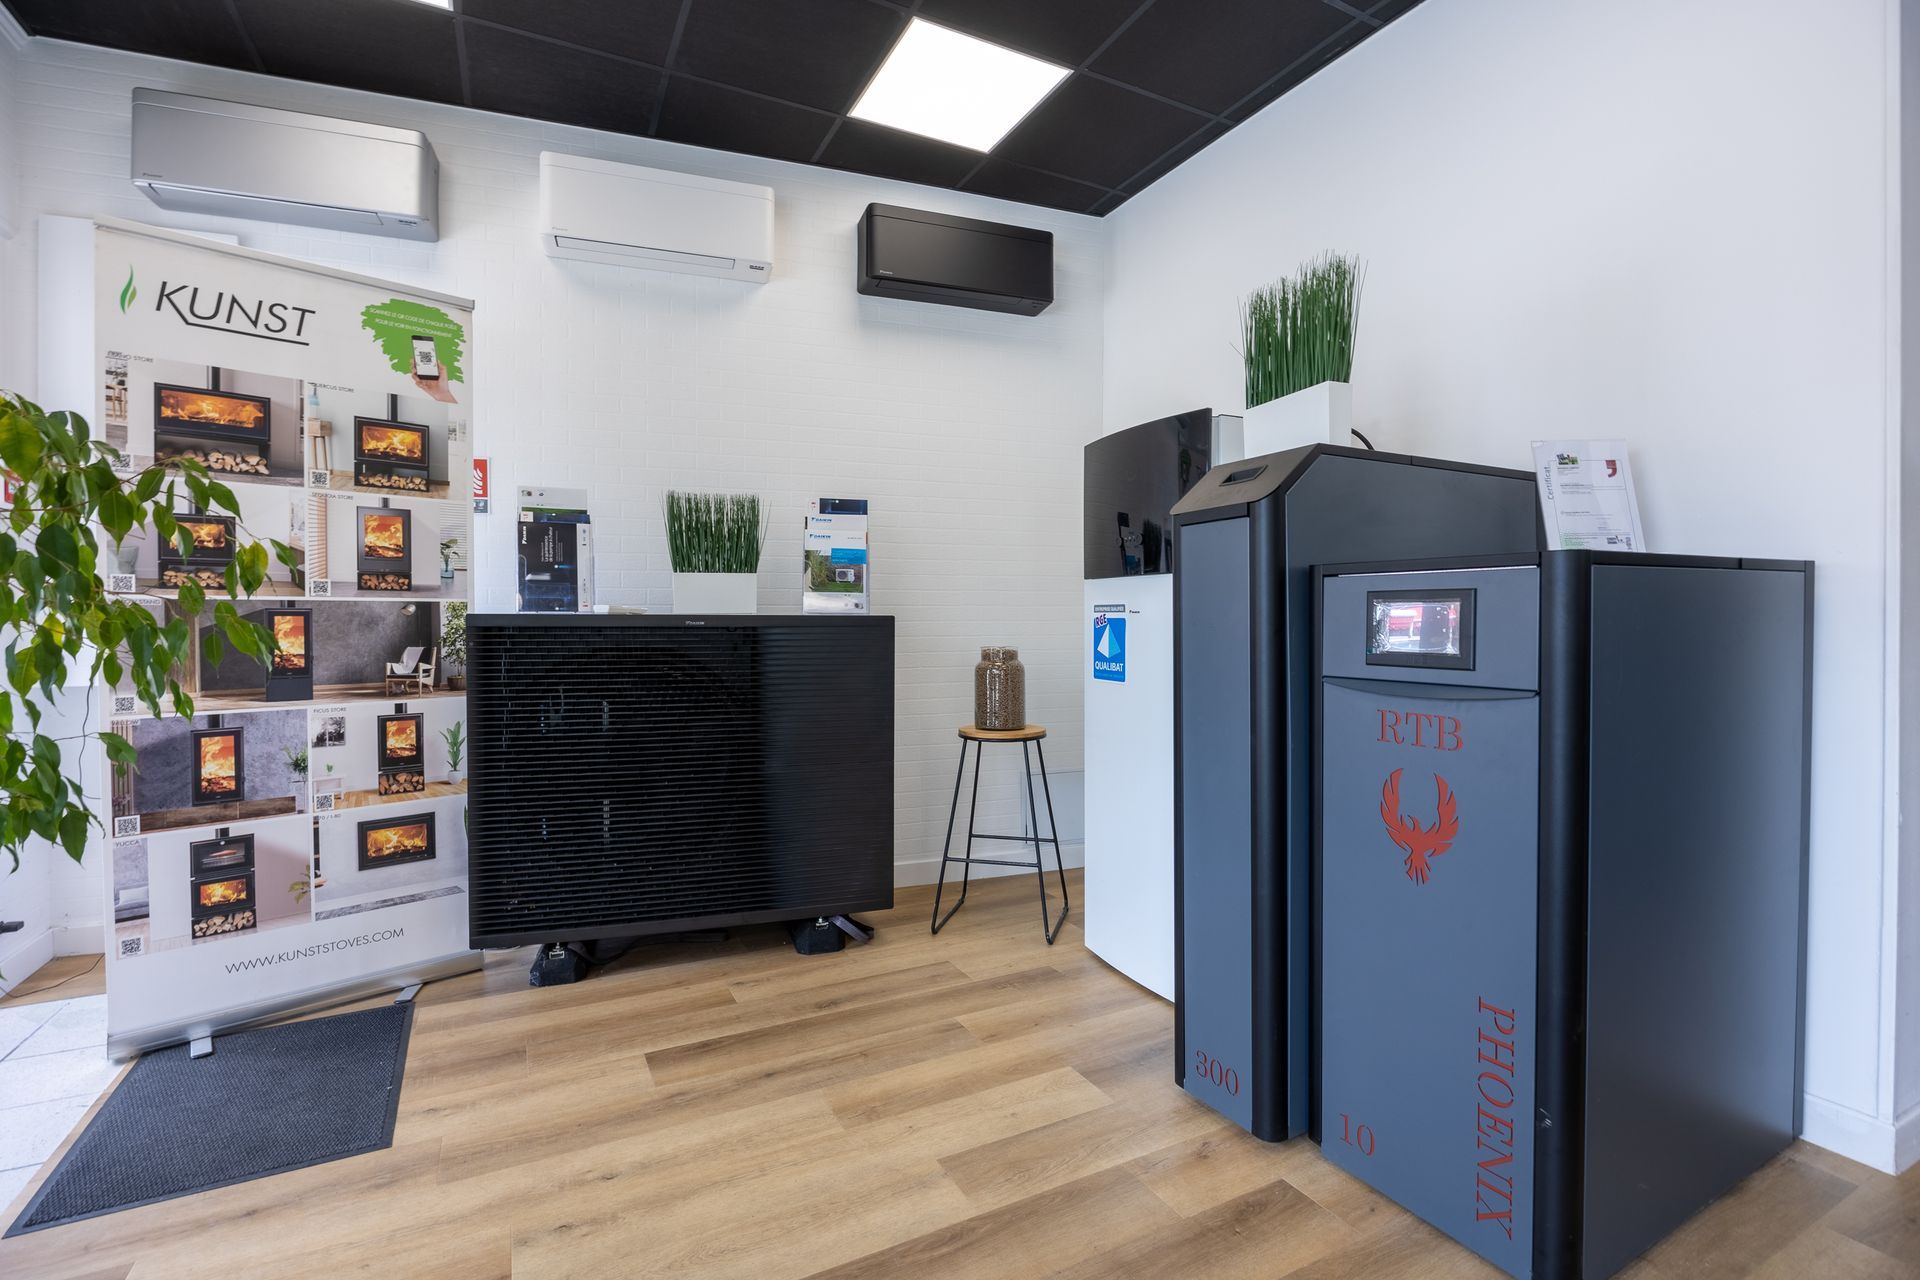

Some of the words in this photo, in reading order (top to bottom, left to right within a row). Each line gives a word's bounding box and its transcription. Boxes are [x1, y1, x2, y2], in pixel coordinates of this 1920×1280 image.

[155, 280, 316, 345] KUNST
[1544, 466, 1554, 500] Certificat
[1095, 614, 1107, 627] RGE
[1095, 661, 1123, 672] QUALIBAT
[1377, 709, 1464, 751] RTB
[225, 928, 405, 974] WWW.KUNSTSTOVES.COM
[1196, 1049, 1240, 1097] 300
[1340, 1112, 1376, 1157] 10
[1476, 995, 1516, 1241] PHOENIX
